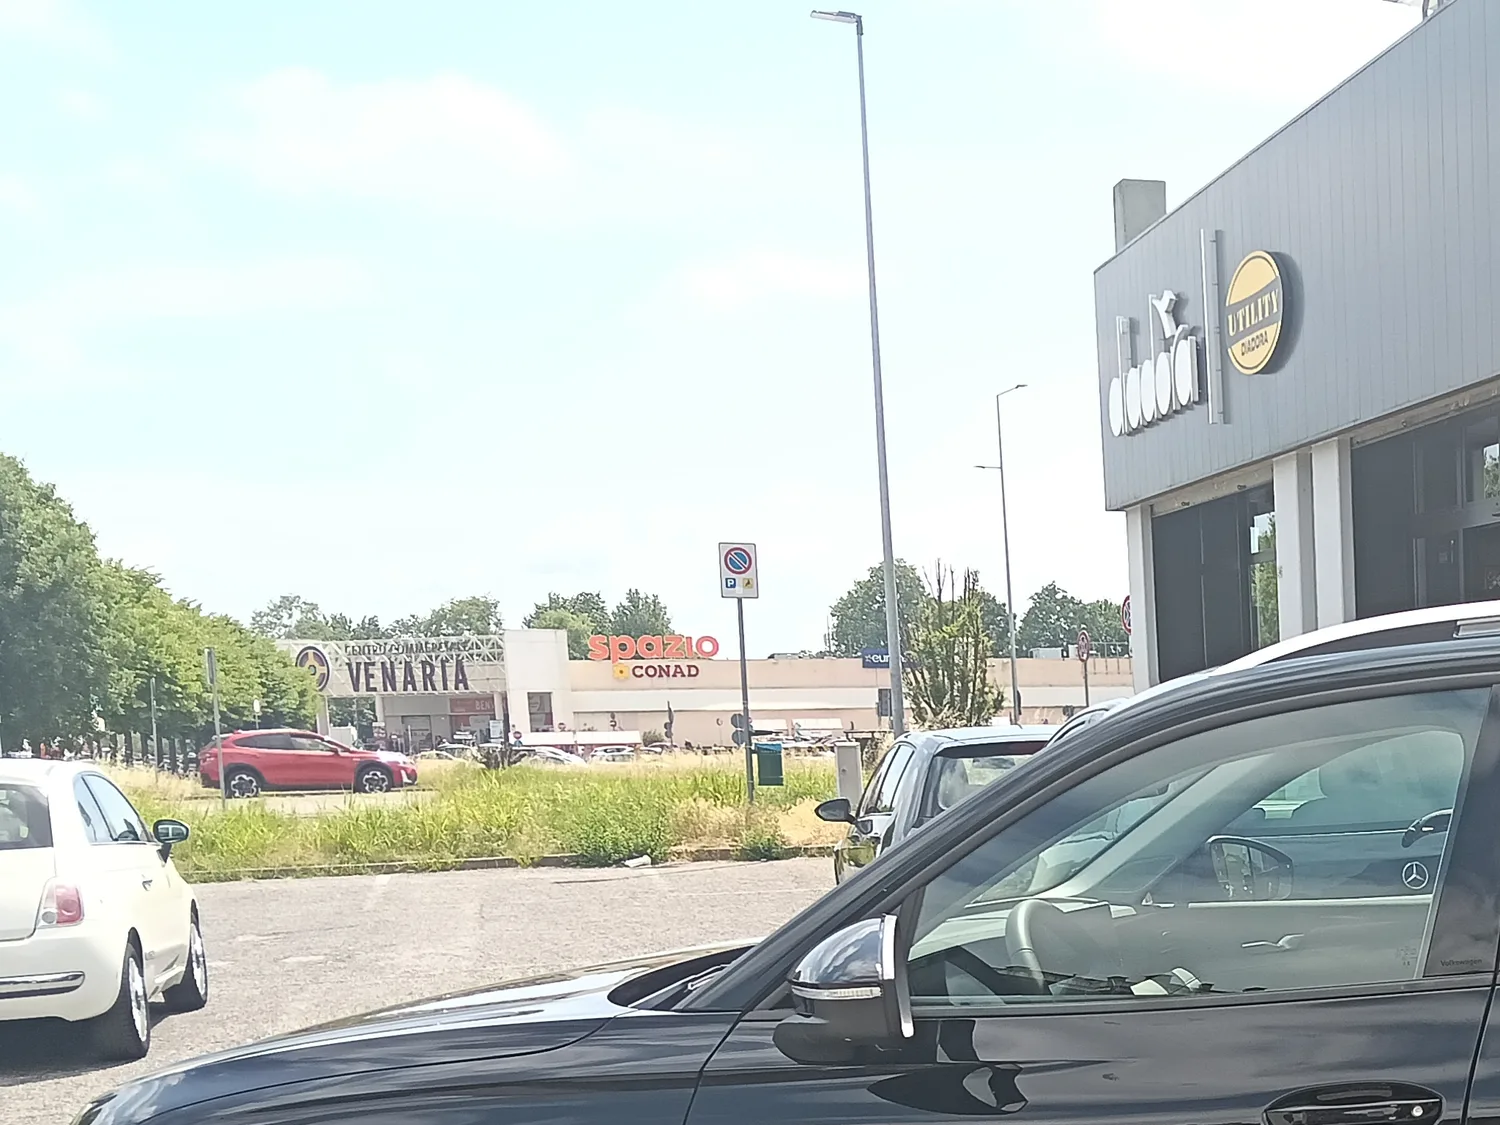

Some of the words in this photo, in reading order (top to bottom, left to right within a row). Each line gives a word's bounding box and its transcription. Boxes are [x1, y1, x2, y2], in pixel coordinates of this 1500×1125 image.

[1228, 288, 1279, 337] UTILITY
[1240, 330, 1270, 356] DIADORA
[588, 634, 719, 664] spazio
[346, 659, 470, 692] VENARIA
[632, 664, 700, 678] CONAD
